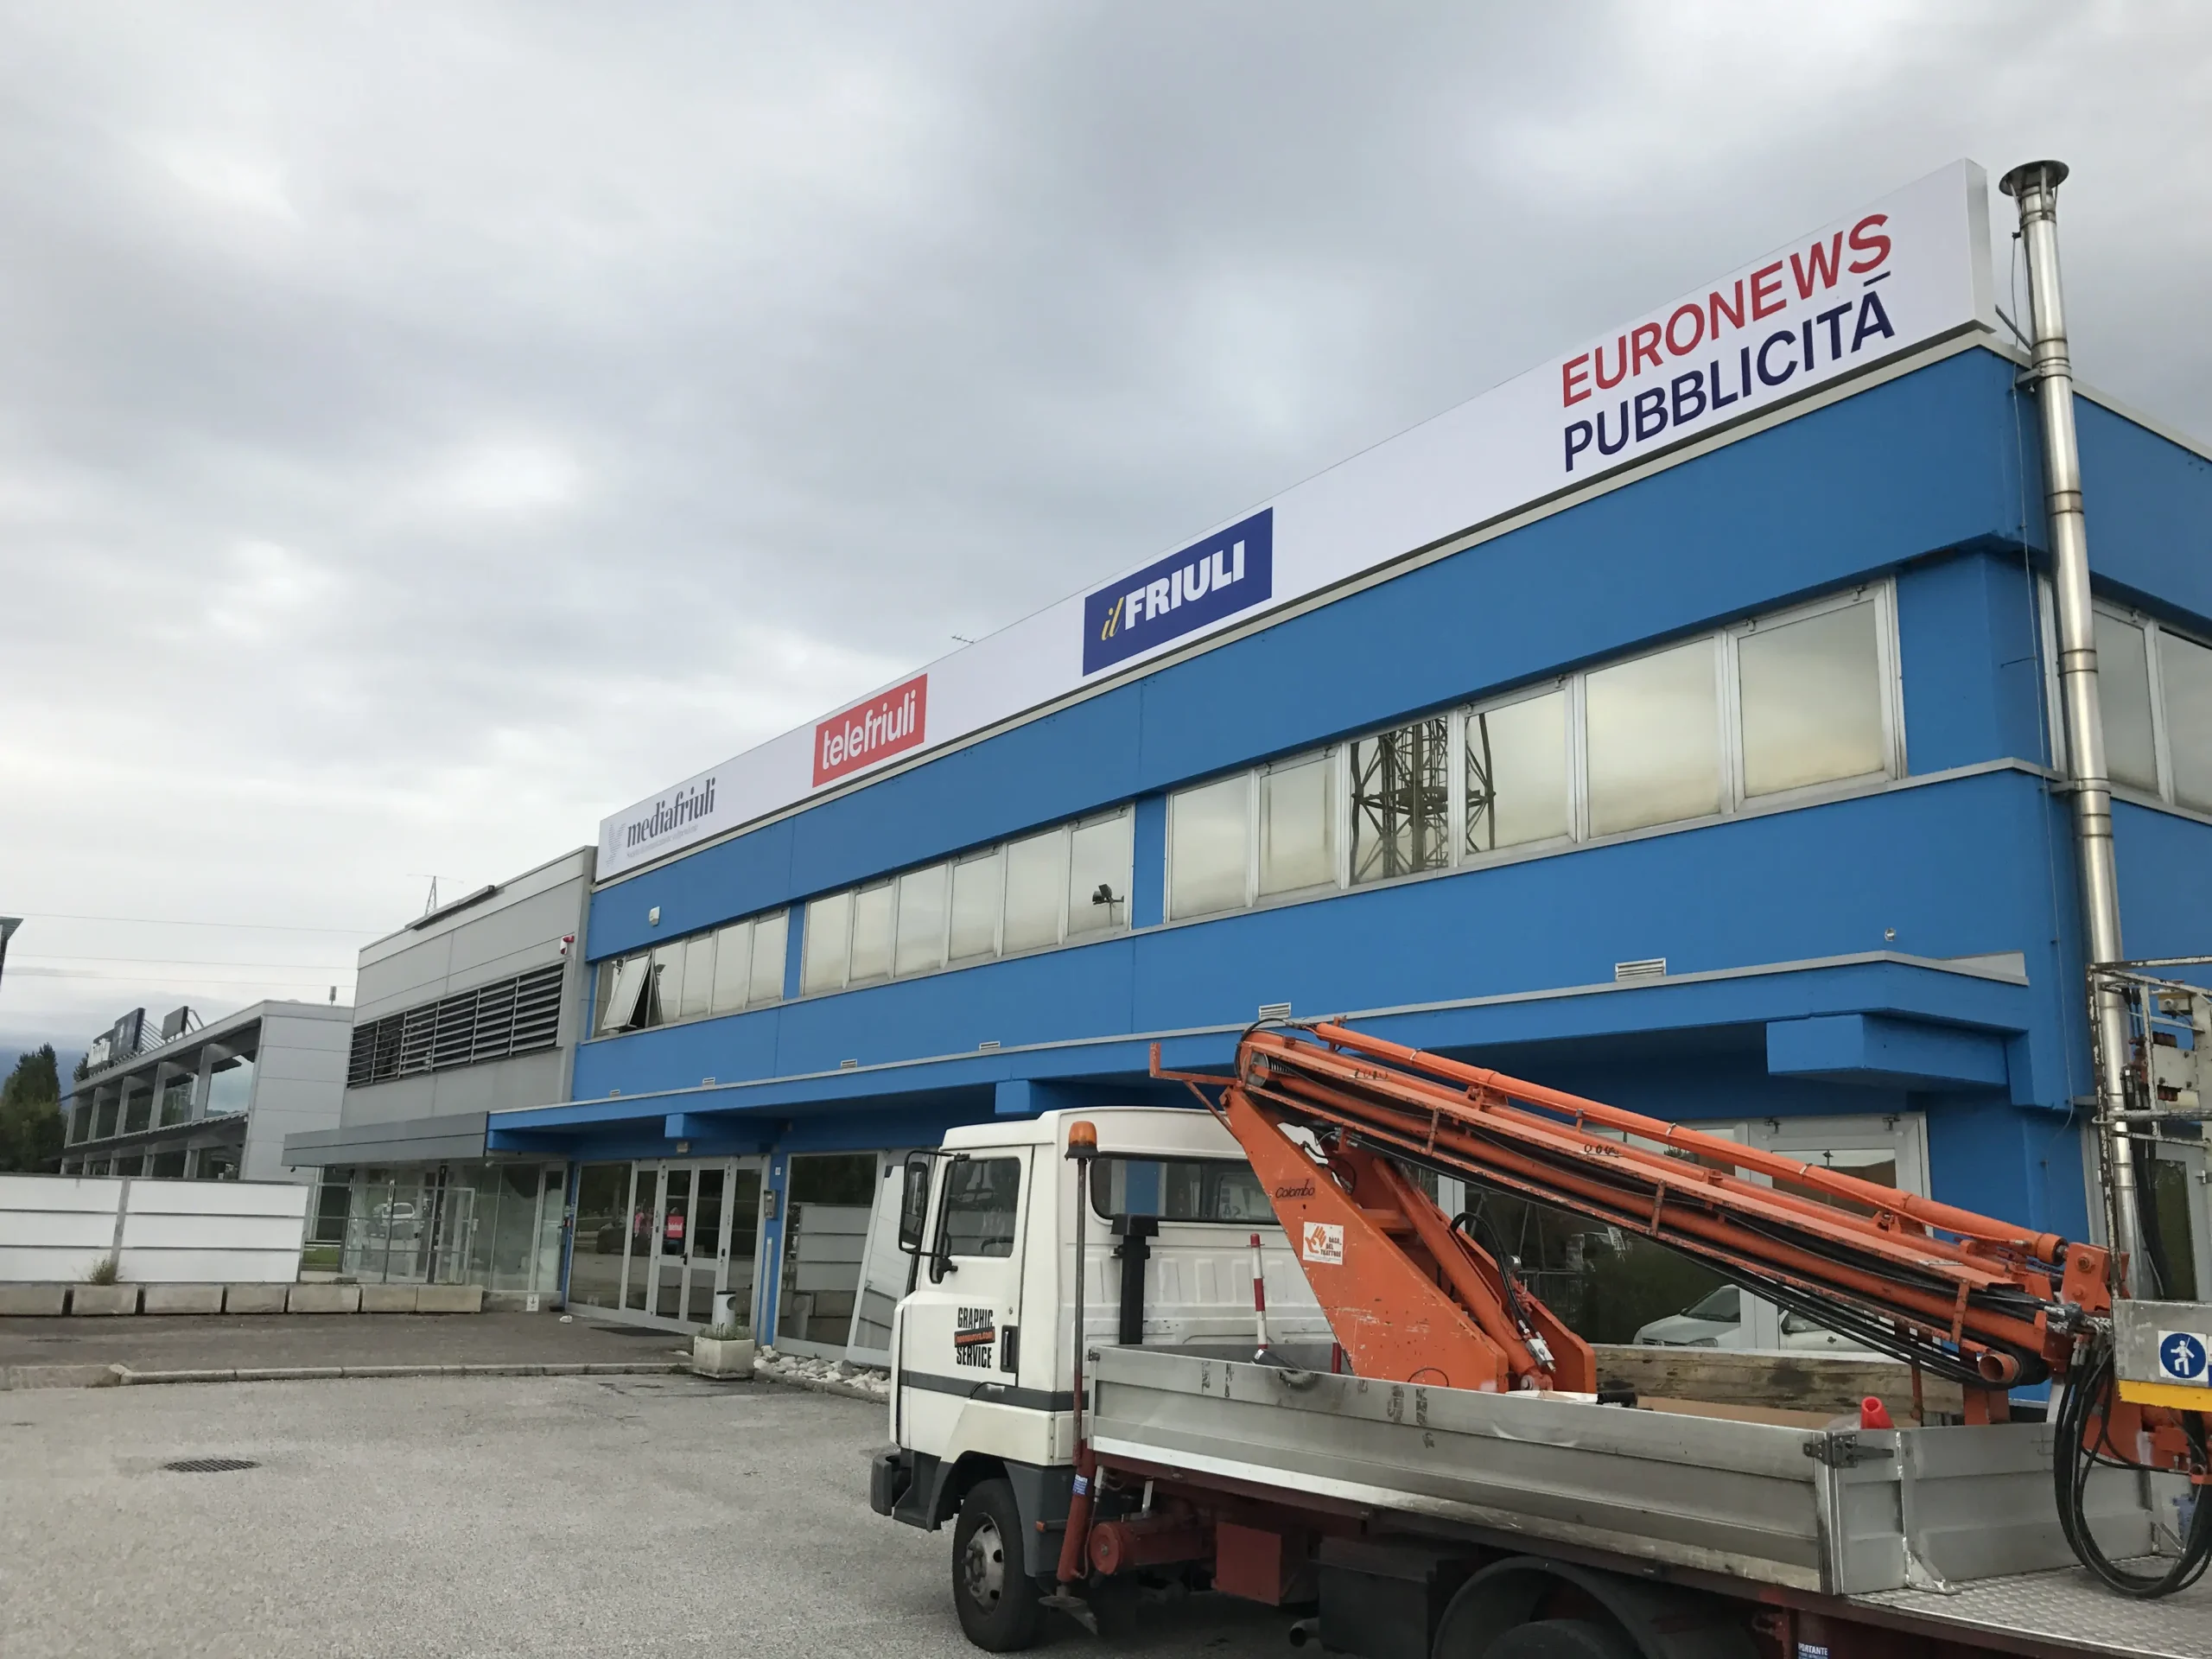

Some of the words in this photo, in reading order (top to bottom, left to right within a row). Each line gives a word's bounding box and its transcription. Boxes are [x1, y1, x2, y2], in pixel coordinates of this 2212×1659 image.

[1562, 213, 1891, 408] EURONEWS
[1101, 596, 1124, 641] il
[1125, 539, 1245, 631] FRIULI
[823, 690, 916, 770] telefriuli
[627, 777, 715, 848] mediafriuli
[1275, 1179, 1315, 1198] Colombo
[957, 1306, 994, 1329] GRAPHIC
[956, 1345, 992, 1370] SERVICE
